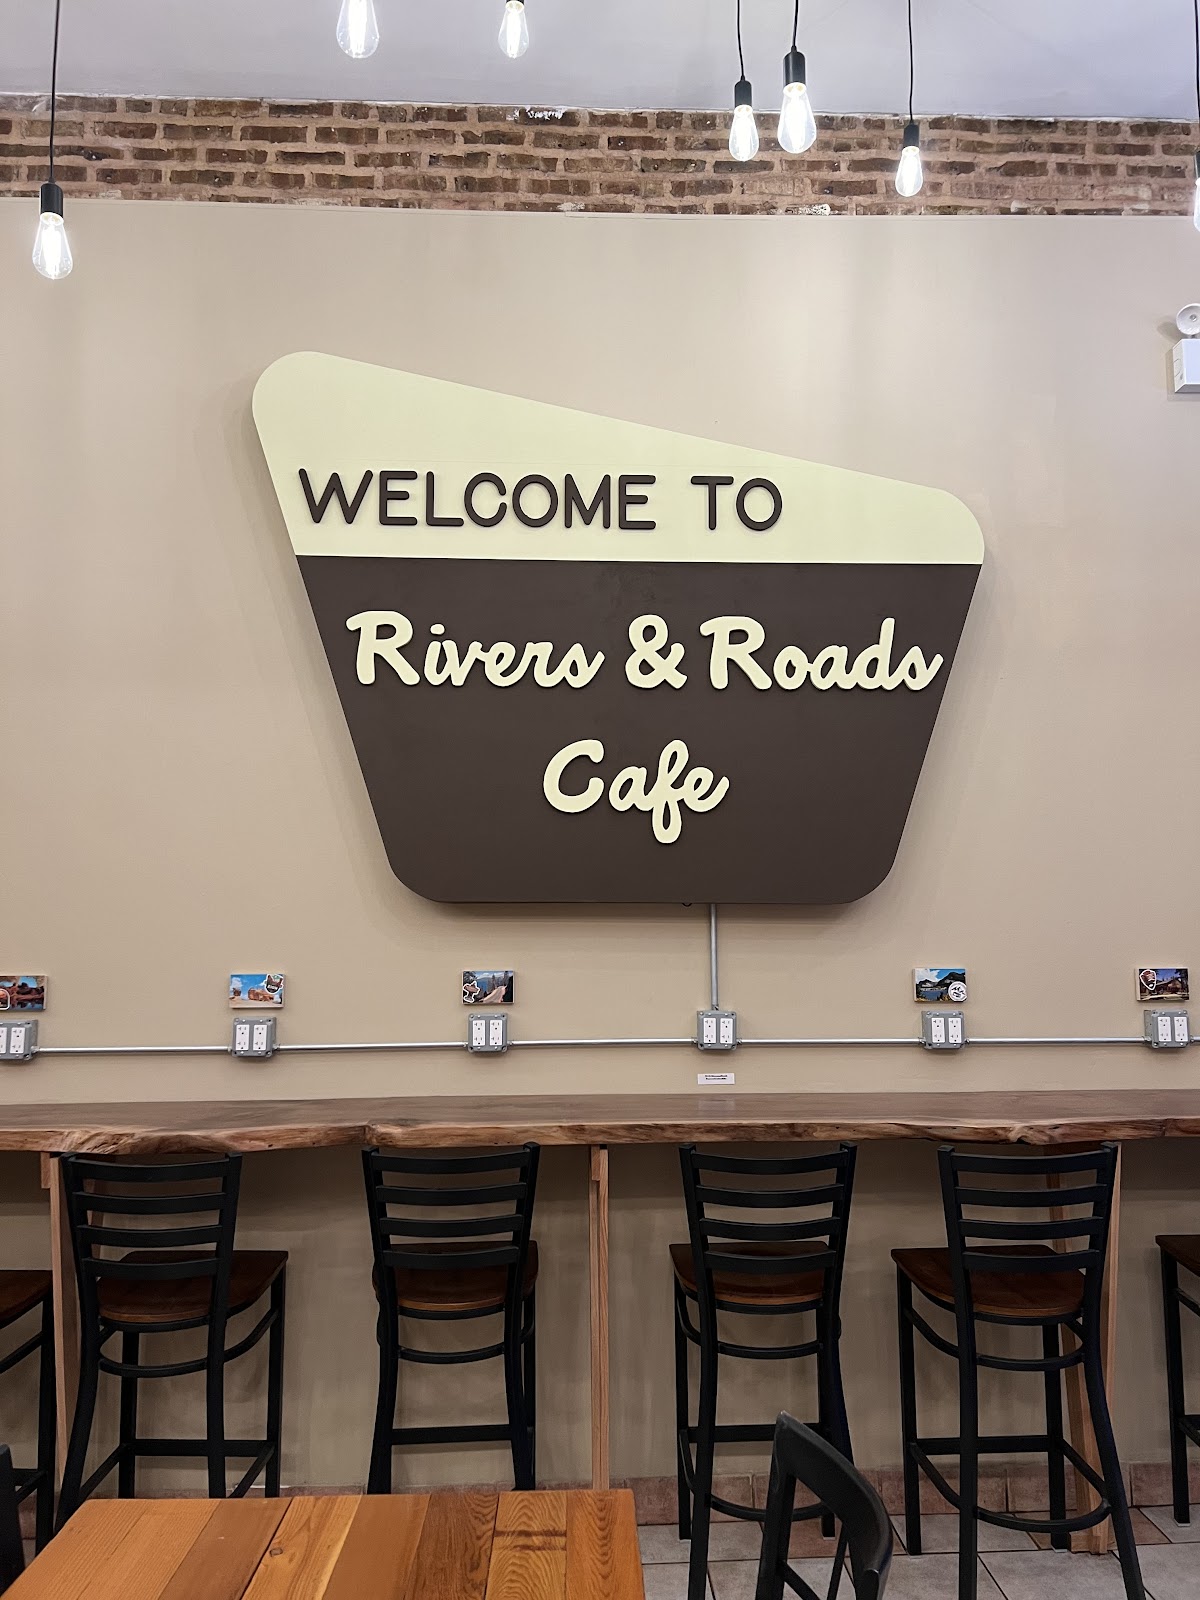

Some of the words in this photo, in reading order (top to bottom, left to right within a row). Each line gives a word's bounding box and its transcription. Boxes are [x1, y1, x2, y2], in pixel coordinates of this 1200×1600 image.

[299, 468, 657, 530] WELCOME
[691, 475, 783, 531] TO
[346, 610, 605, 688] Rivers
[626, 614, 688, 688] &
[700, 616, 942, 691] Roads
[543, 740, 730, 844] Cafe
